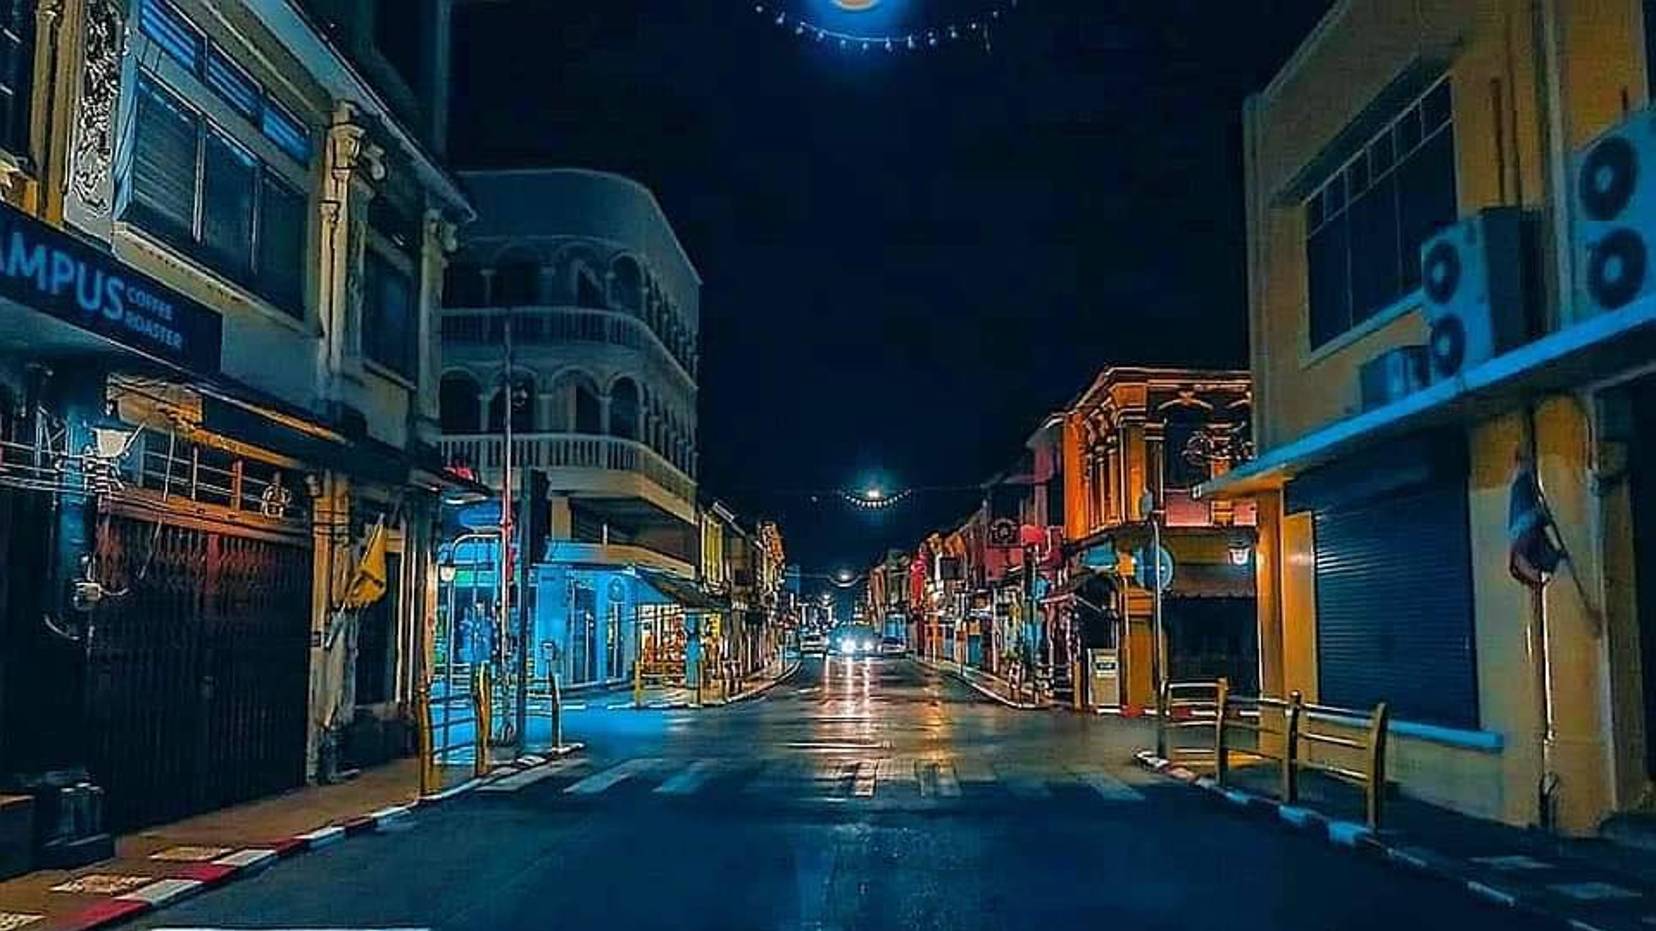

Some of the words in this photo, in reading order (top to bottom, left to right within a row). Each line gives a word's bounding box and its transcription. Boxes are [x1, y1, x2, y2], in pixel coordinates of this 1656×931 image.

[0, 232, 125, 320] MPUS
[126, 286, 173, 321] COFFEE
[125, 310, 183, 347] ROASTER
